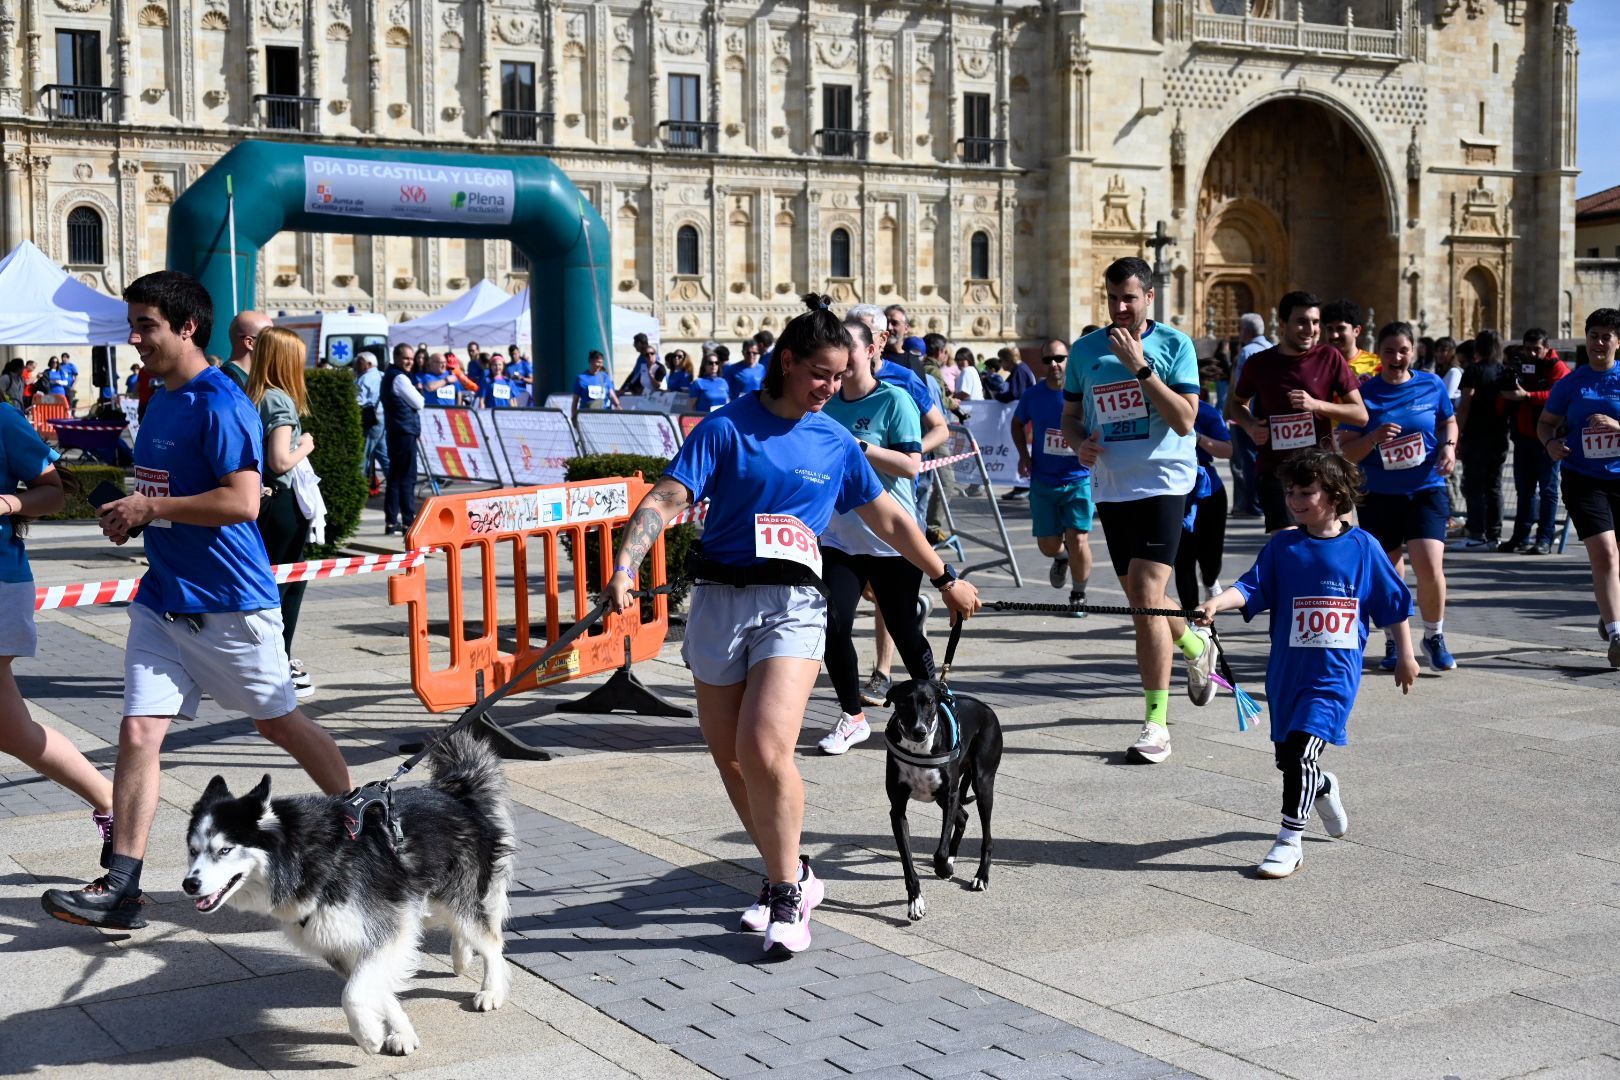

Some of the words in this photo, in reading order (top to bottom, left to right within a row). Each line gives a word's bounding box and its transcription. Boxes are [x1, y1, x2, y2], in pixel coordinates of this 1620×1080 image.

[313, 160, 343, 176] DÍA
[347, 163, 369, 177] DE
[372, 165, 448, 183] CASTILLA
[450, 171, 460, 184] Y
[464, 171, 507, 187] LEÓN
[468, 192, 505, 206] Plena
[1097, 390, 1143, 413] 1152
[1112, 420, 1136, 434] 261
[1273, 422, 1314, 440] 1022
[1384, 441, 1423, 464] 1207
[986, 460, 1005, 472] eón
[760, 527, 818, 561] 1091
[1295, 610, 1356, 634] 1007
